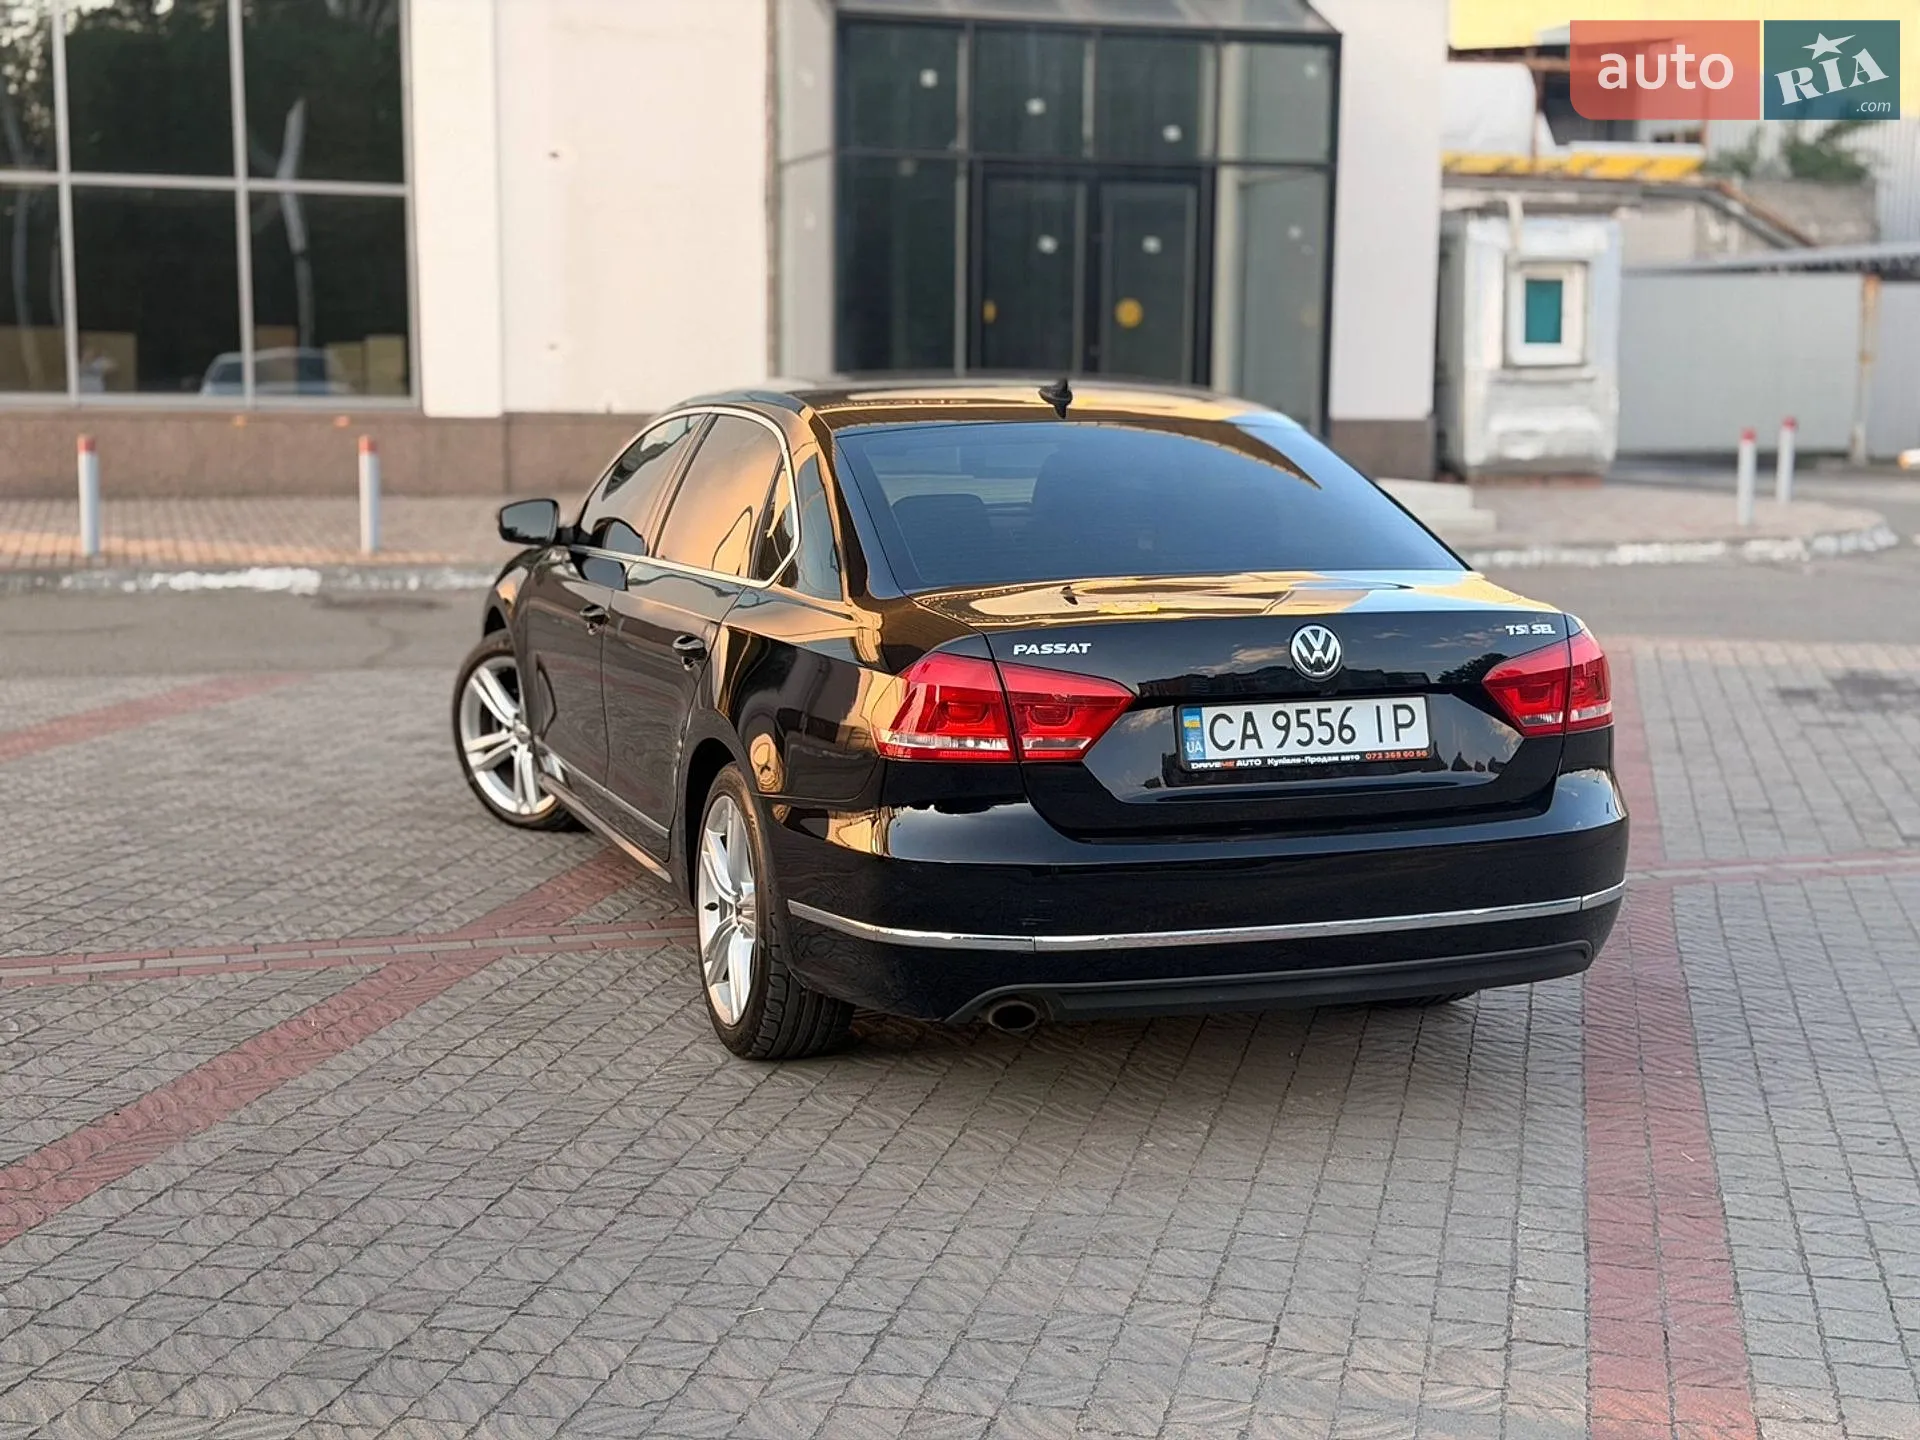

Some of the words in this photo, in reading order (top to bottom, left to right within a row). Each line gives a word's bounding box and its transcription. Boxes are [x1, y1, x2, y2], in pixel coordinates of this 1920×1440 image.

[1531, 623, 1556, 635] SEL
[1013, 642, 1092, 655] PASSAT
[1209, 711, 1264, 752] CA
[1272, 706, 1356, 749] 9556
[1375, 703, 1416, 743] IP
[1186, 741, 1204, 753] UA
[1236, 758, 1262, 767] AUTO
